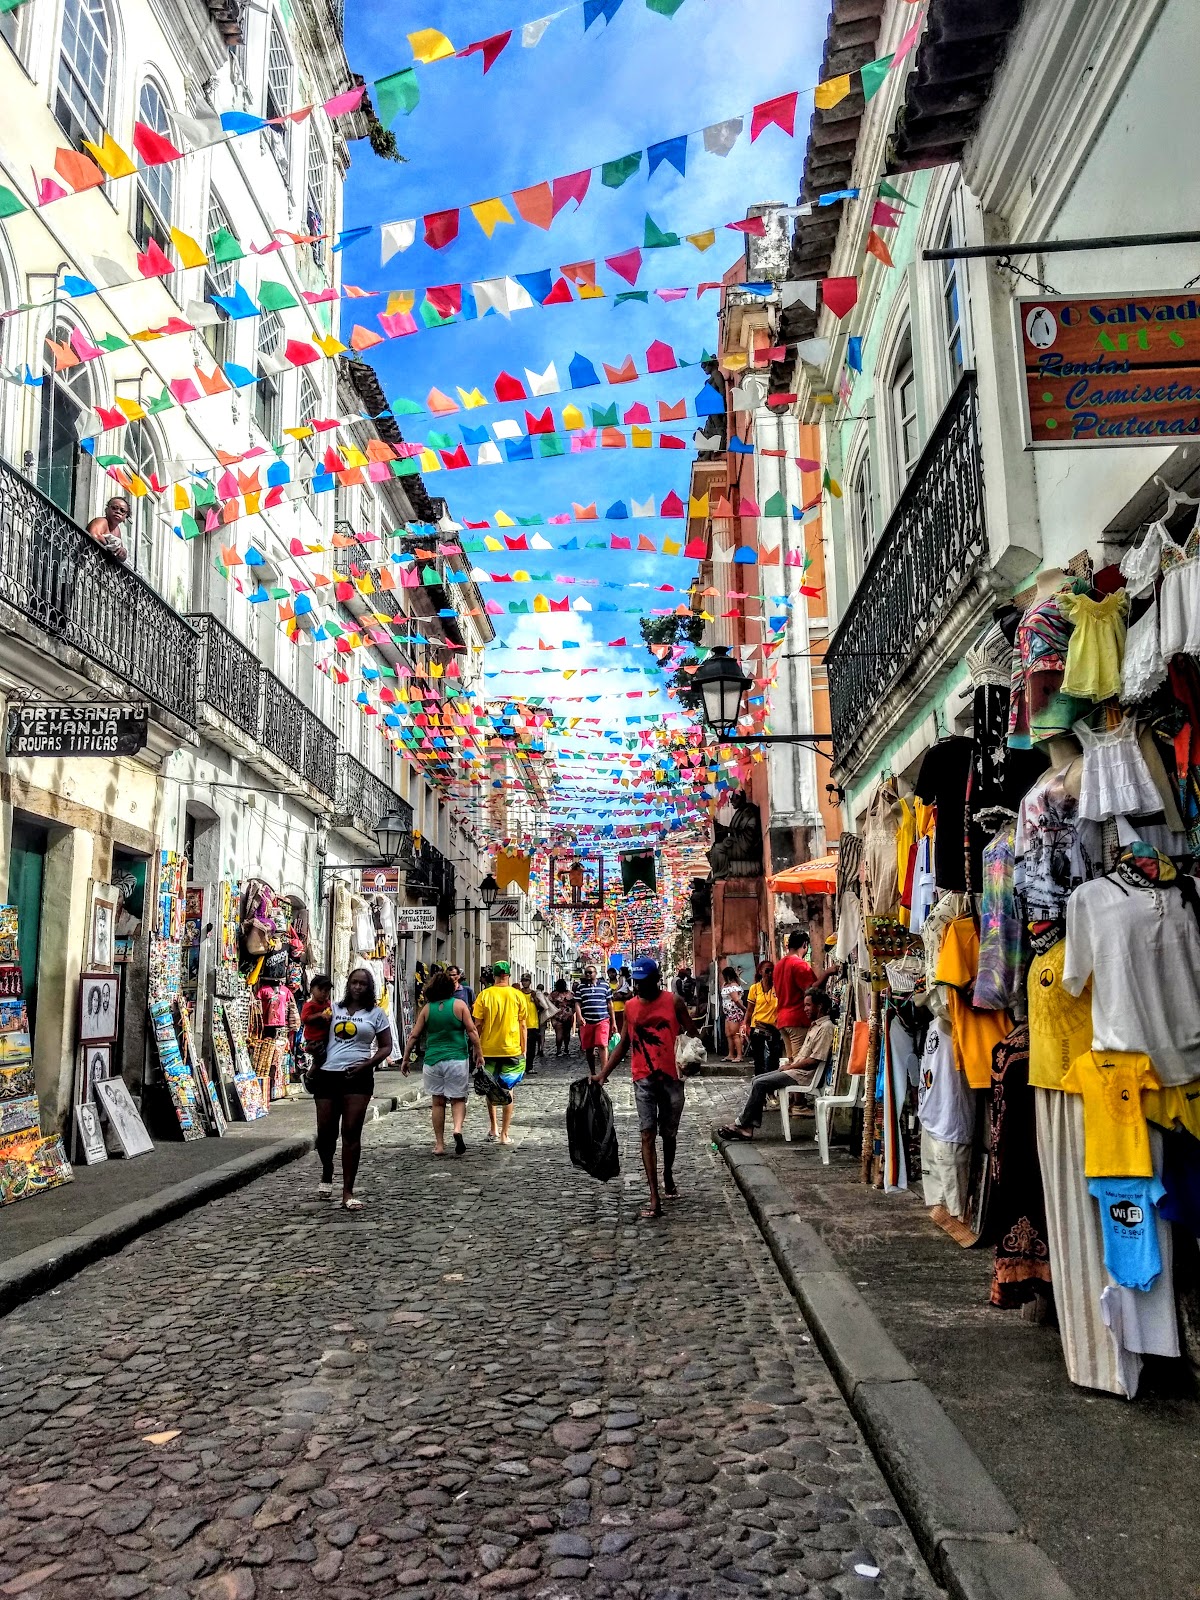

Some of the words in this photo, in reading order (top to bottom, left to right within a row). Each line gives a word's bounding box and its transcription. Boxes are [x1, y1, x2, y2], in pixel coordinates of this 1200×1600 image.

[1060, 306, 1082, 327] O
[1088, 300, 1200, 326] Salvad
[1038, 352, 1132, 379] Rendas
[21, 707, 144, 721] ARTESANATO
[18, 736, 62, 751] ROUPAS
